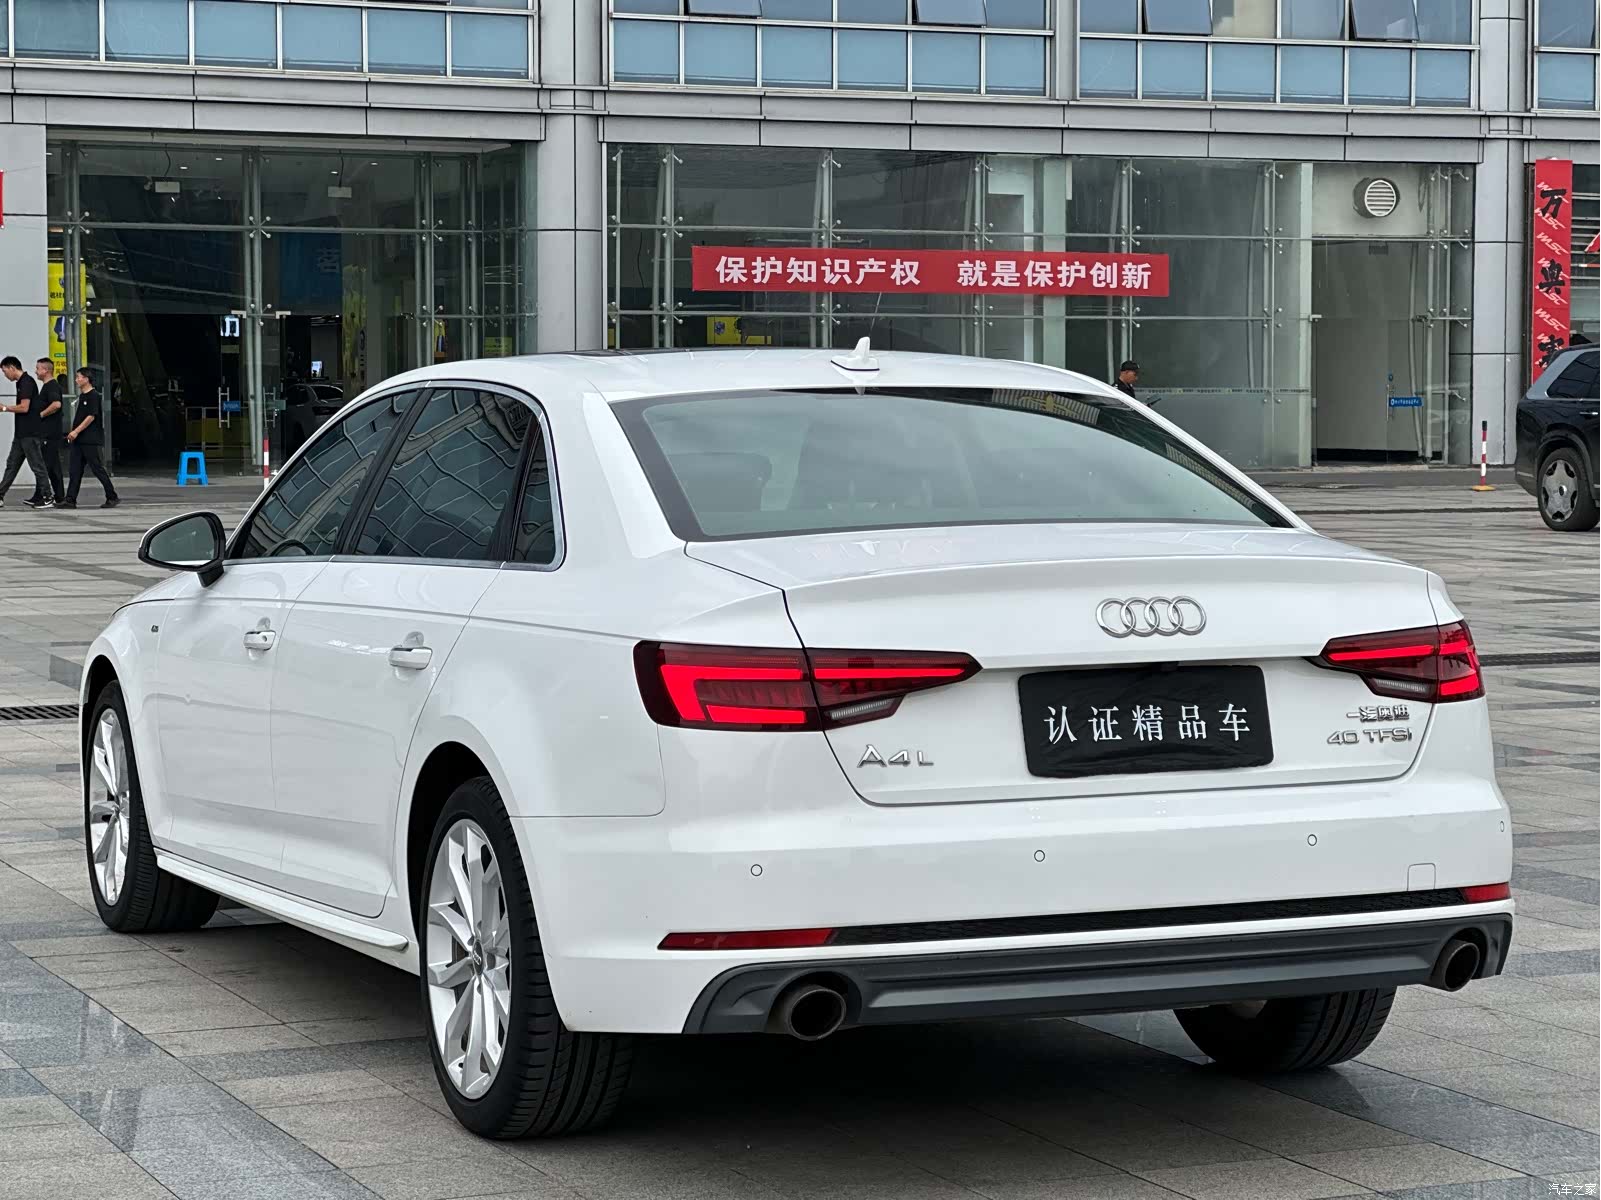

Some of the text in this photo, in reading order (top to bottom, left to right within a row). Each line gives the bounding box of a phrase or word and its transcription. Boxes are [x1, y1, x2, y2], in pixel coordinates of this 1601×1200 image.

[715, 256, 1153, 290] 保护知识产权 就是保护创新
[1043, 703, 1251, 744] 认证精品车
[1327, 727, 1413, 745] 40 TFSI
